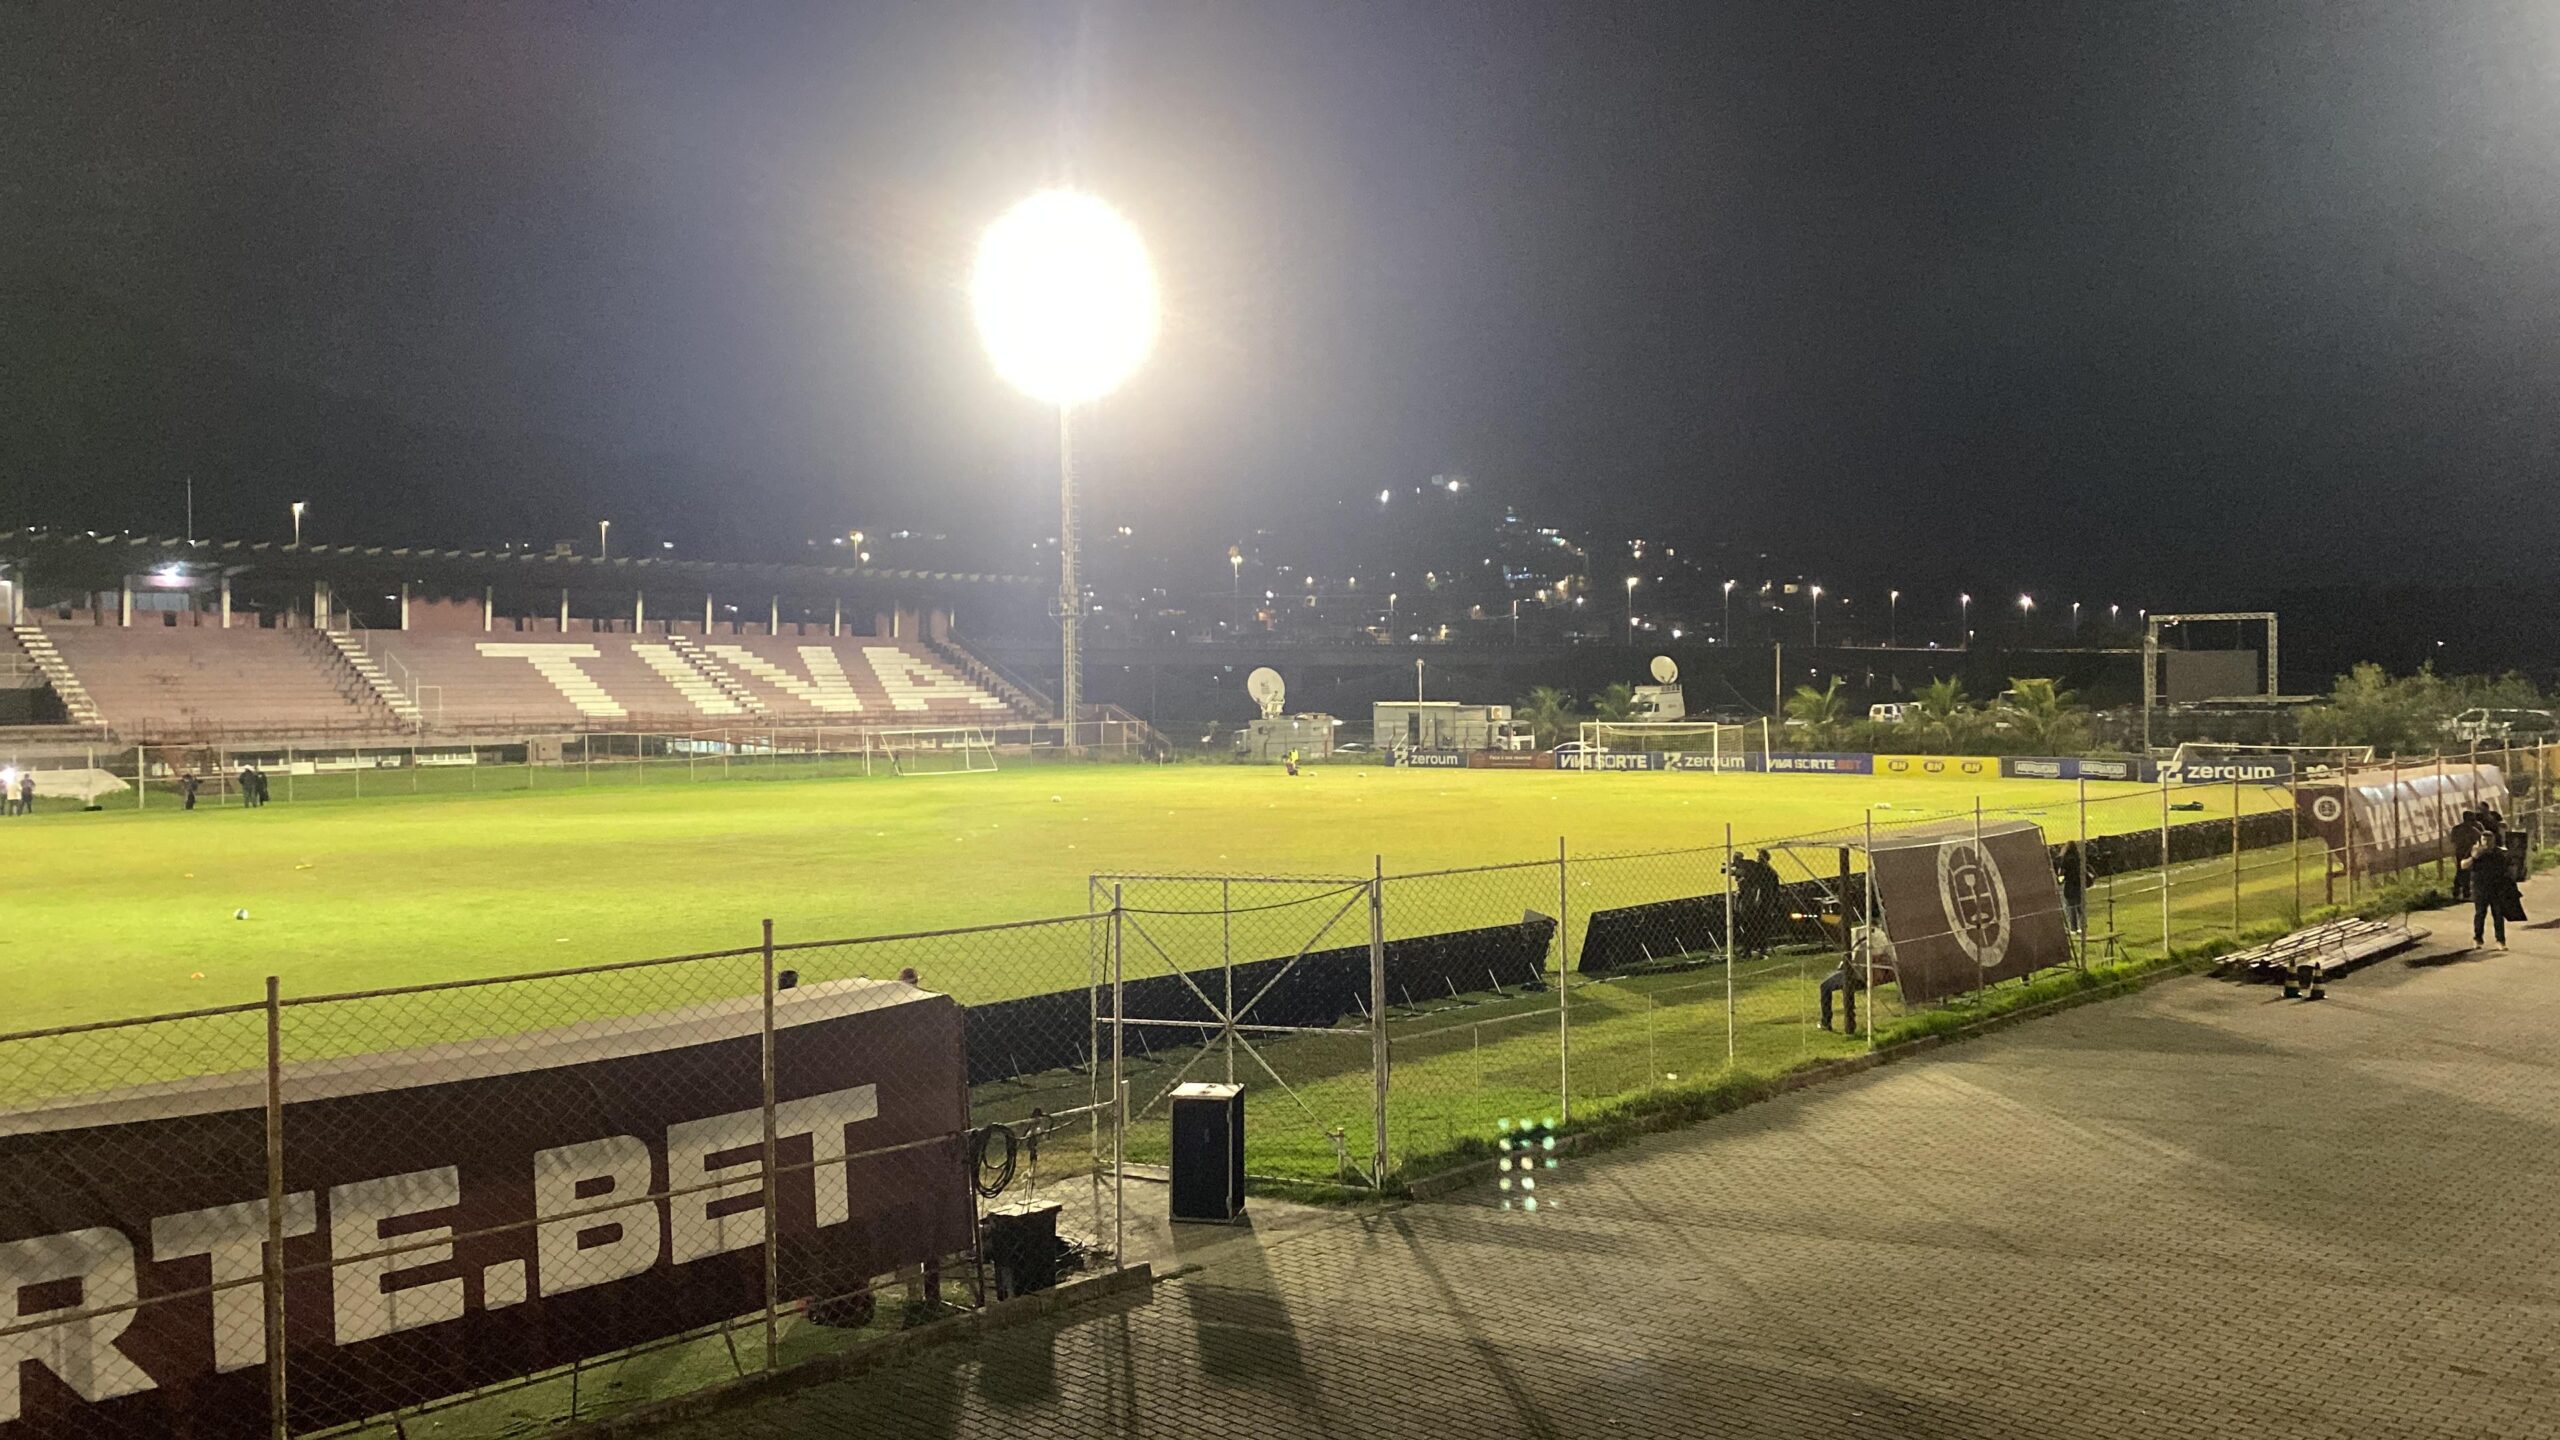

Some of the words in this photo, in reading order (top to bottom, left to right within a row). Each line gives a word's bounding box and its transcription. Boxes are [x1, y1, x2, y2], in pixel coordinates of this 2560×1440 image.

[475, 643, 1006, 716] TIVA
[1411, 753, 1458, 765] zeroum
[1560, 754, 1592, 768] VIVA
[1595, 754, 1647, 768] SORTE
[1685, 755, 1745, 768] zeroum
[1768, 759, 1792, 768] VIVA
[2187, 764, 2275, 779] zeroum
